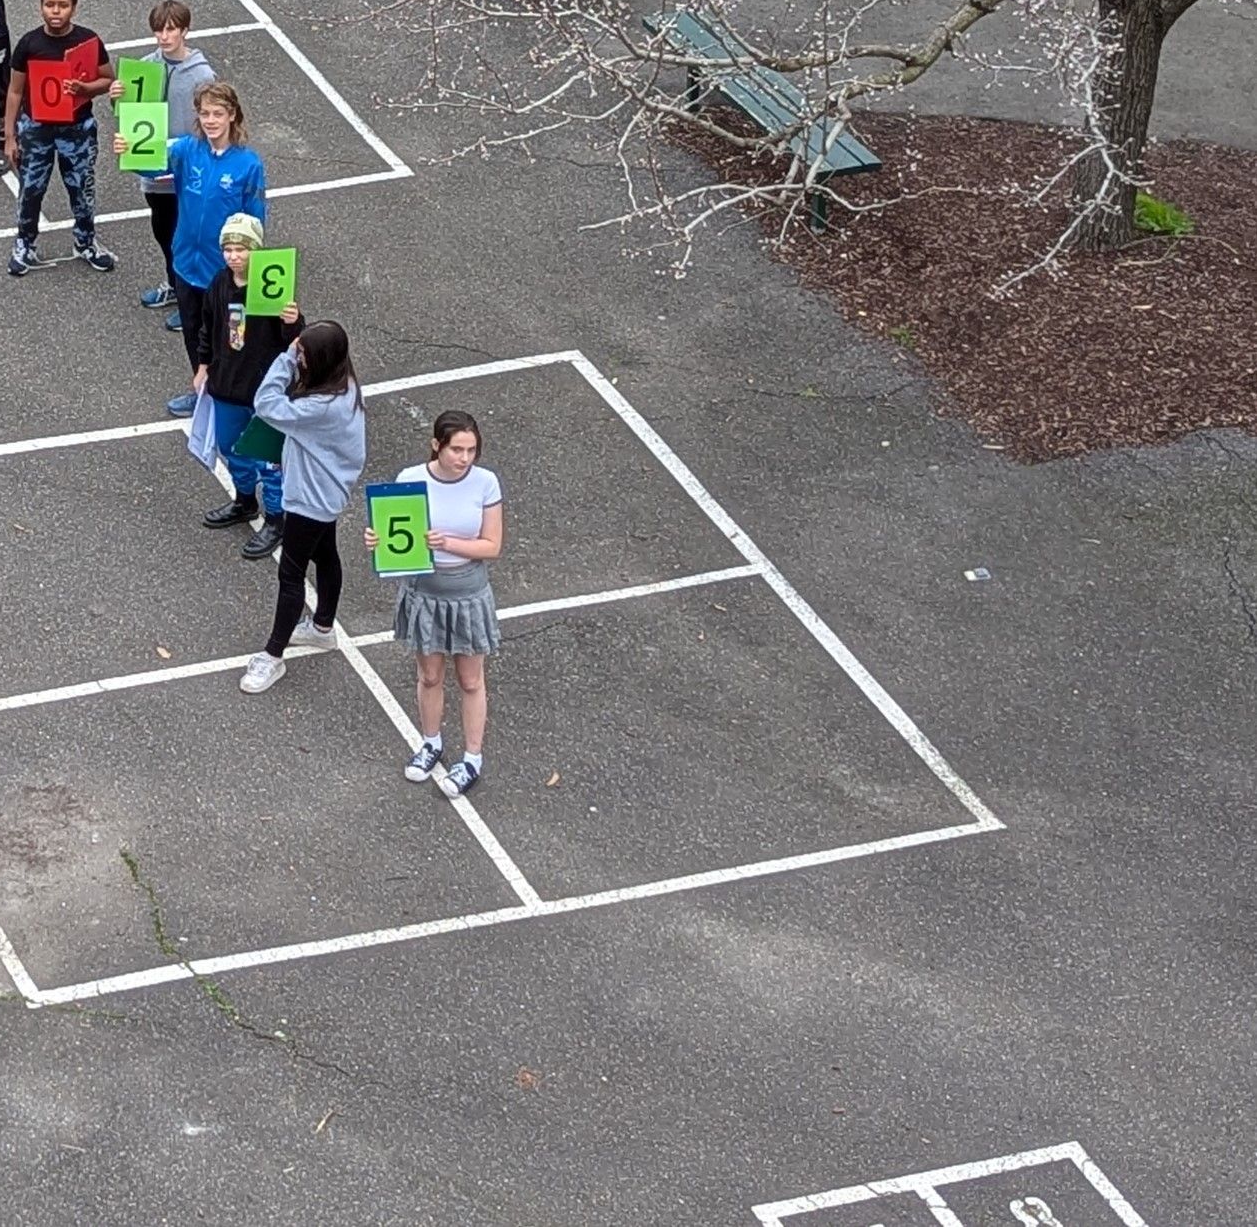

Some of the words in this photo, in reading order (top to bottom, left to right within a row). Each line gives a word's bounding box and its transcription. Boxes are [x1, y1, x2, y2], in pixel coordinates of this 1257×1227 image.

[41, 77, 62, 108] 0
[131, 76, 145, 102] 1
[131, 120, 155, 155] 2
[387, 516, 414, 555] 5
